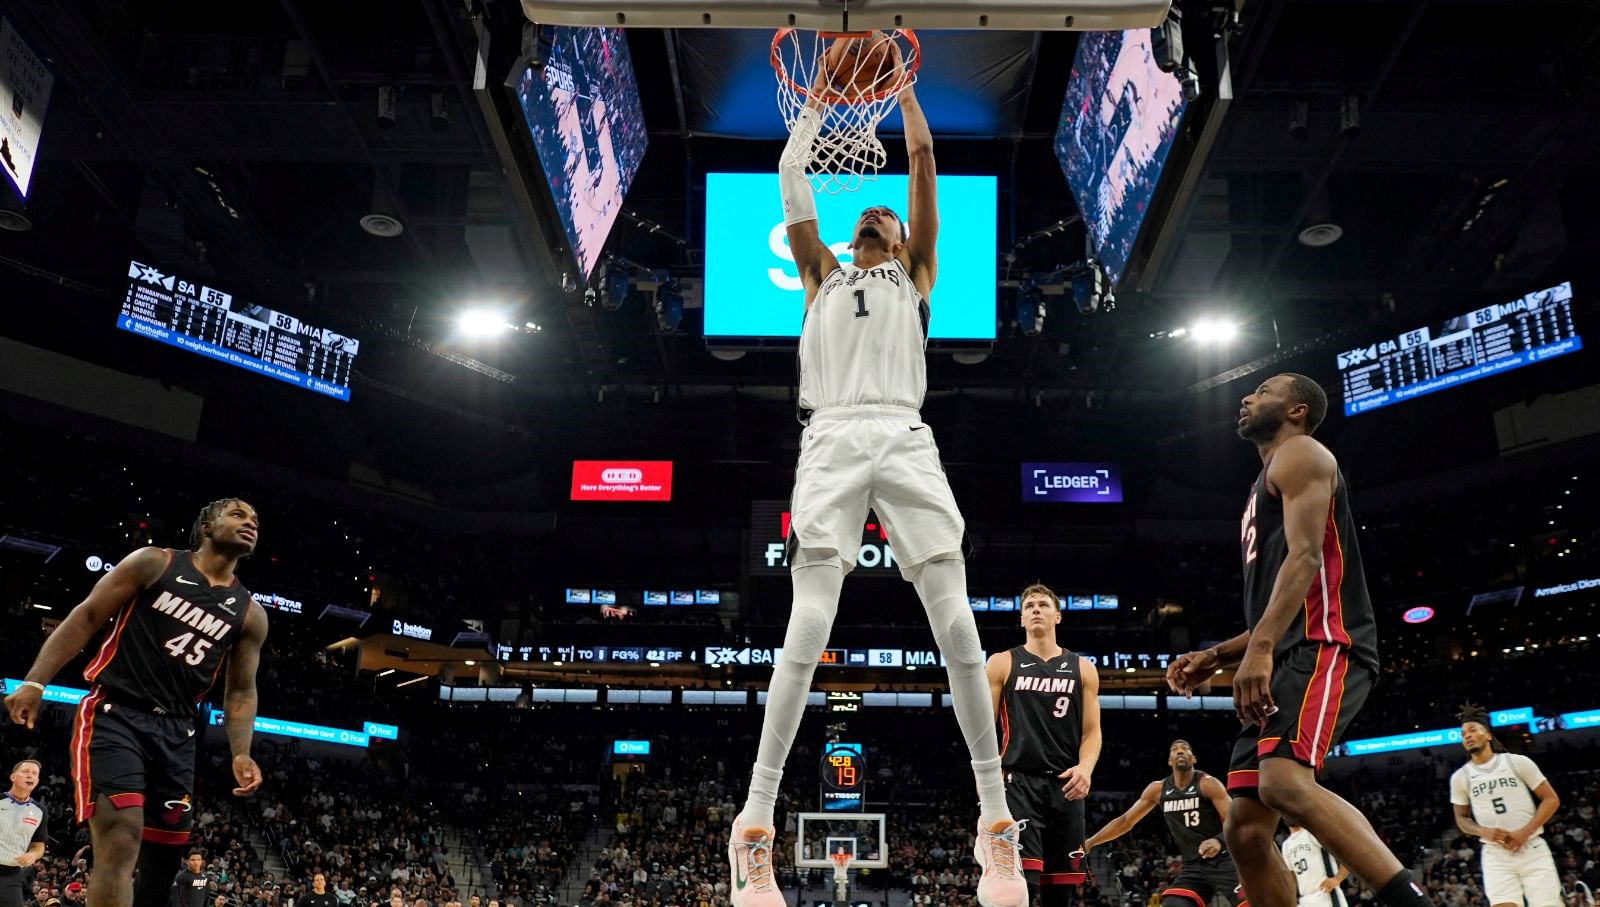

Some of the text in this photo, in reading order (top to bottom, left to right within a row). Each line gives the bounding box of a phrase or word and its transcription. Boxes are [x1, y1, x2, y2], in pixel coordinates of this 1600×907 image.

[177, 280, 321, 340] SA 55 58 MIA
[853, 289, 869, 318] 1
[134, 322, 169, 339] Methodist
[1378, 298, 1527, 355] SA 55 58 MIA
[184, 340, 228, 360] neighborhood
[229, 352, 243, 364] ERs
[243, 360, 263, 370] across
[263, 365, 276, 374] San
[276, 369, 300, 382] Antonio
[1495, 357, 1522, 371] Antonio
[314, 380, 344, 396] Methodist
[598, 484, 639, 493] Everything's
[1044, 475, 1099, 488] LEDGER
[151, 590, 232, 641] MIAMI
[164, 631, 214, 667] 45
[577, 649, 594, 660] TO
[612, 650, 640, 661] FG%
[667, 651, 682, 661] PF
[751, 648, 773, 664] SA
[879, 652, 892, 664] 58
[905, 652, 936, 665] MIA
[1014, 676, 1076, 694] MIAMI
[1054, 696, 1070, 719] 9
[1508, 712, 1526, 721] Frost
[349, 734, 366, 744] Frost
[376, 727, 393, 736] Frost
[829, 755, 851, 767] 42.8
[837, 766, 856, 786] 19
[1472, 777, 1518, 798] SPURS
[1163, 796, 1200, 813] MIAMI
[1491, 797, 1507, 815] 5
[1183, 811, 1200, 828] 13
[1294, 858, 1308, 876] 30
[192, 878, 208, 887] HEAT
